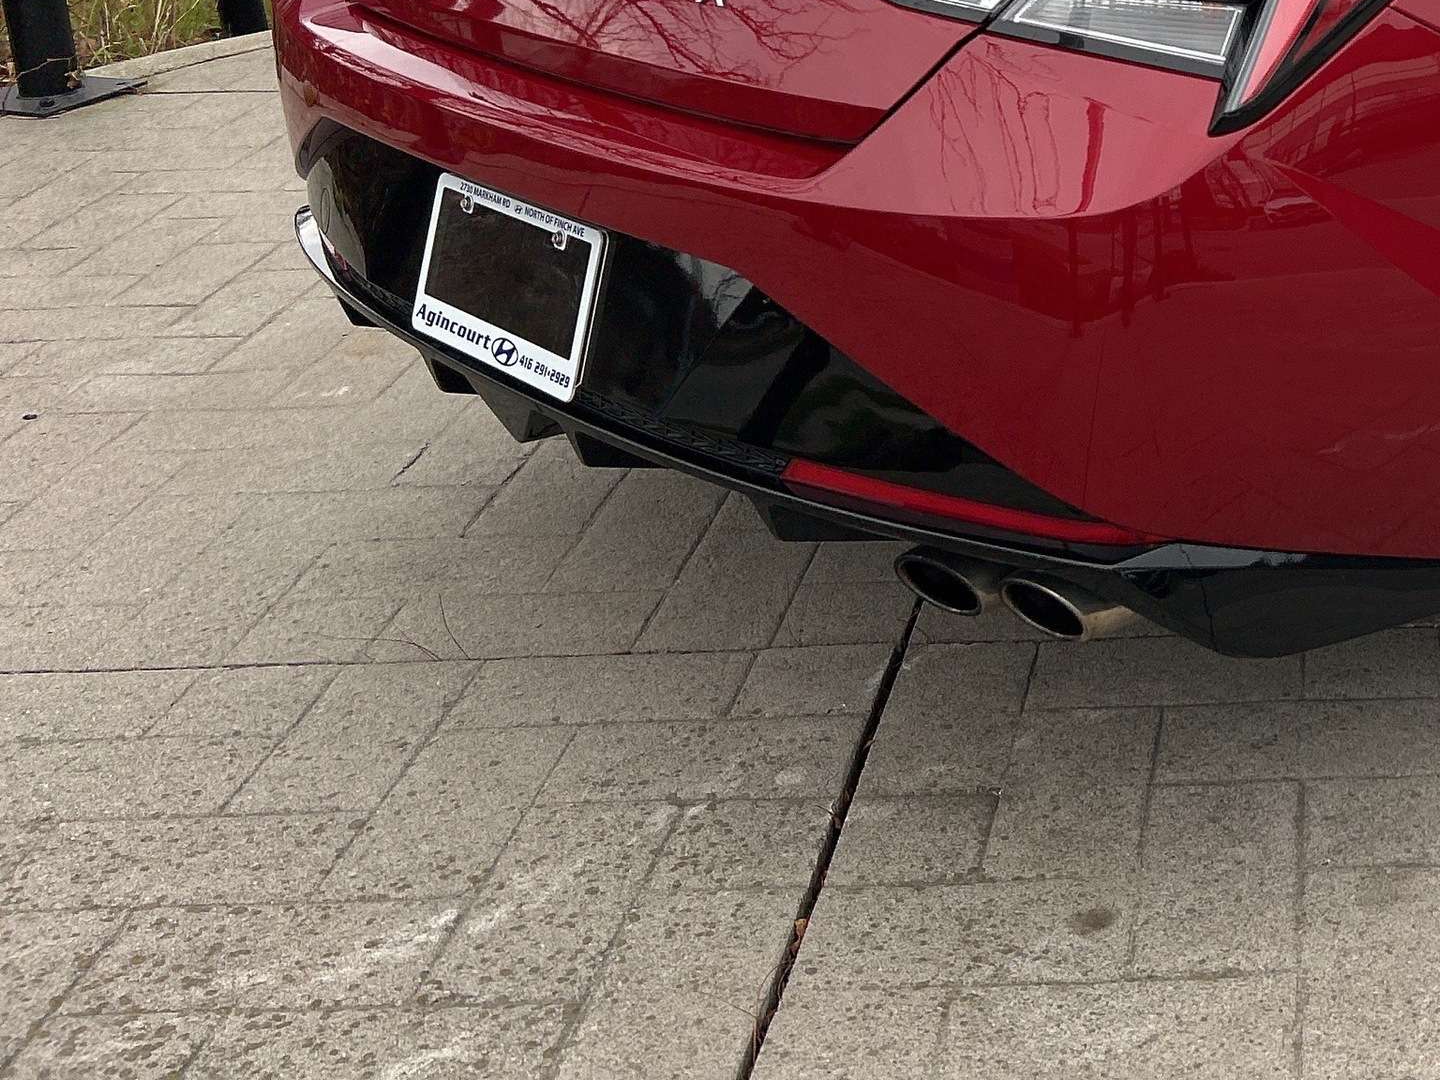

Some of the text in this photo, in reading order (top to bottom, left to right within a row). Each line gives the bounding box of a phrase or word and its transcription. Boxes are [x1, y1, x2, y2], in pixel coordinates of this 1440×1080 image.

[473, 186, 502, 205] MARKHAM
[502, 199, 511, 209] RD
[524, 207, 545, 222] NORTH
[545, 215, 554, 225] OF
[553, 217, 572, 232] FINCH
[572, 223, 585, 238] AVE
[416, 303, 491, 350] Agincourt
[519, 354, 534, 371] 416
